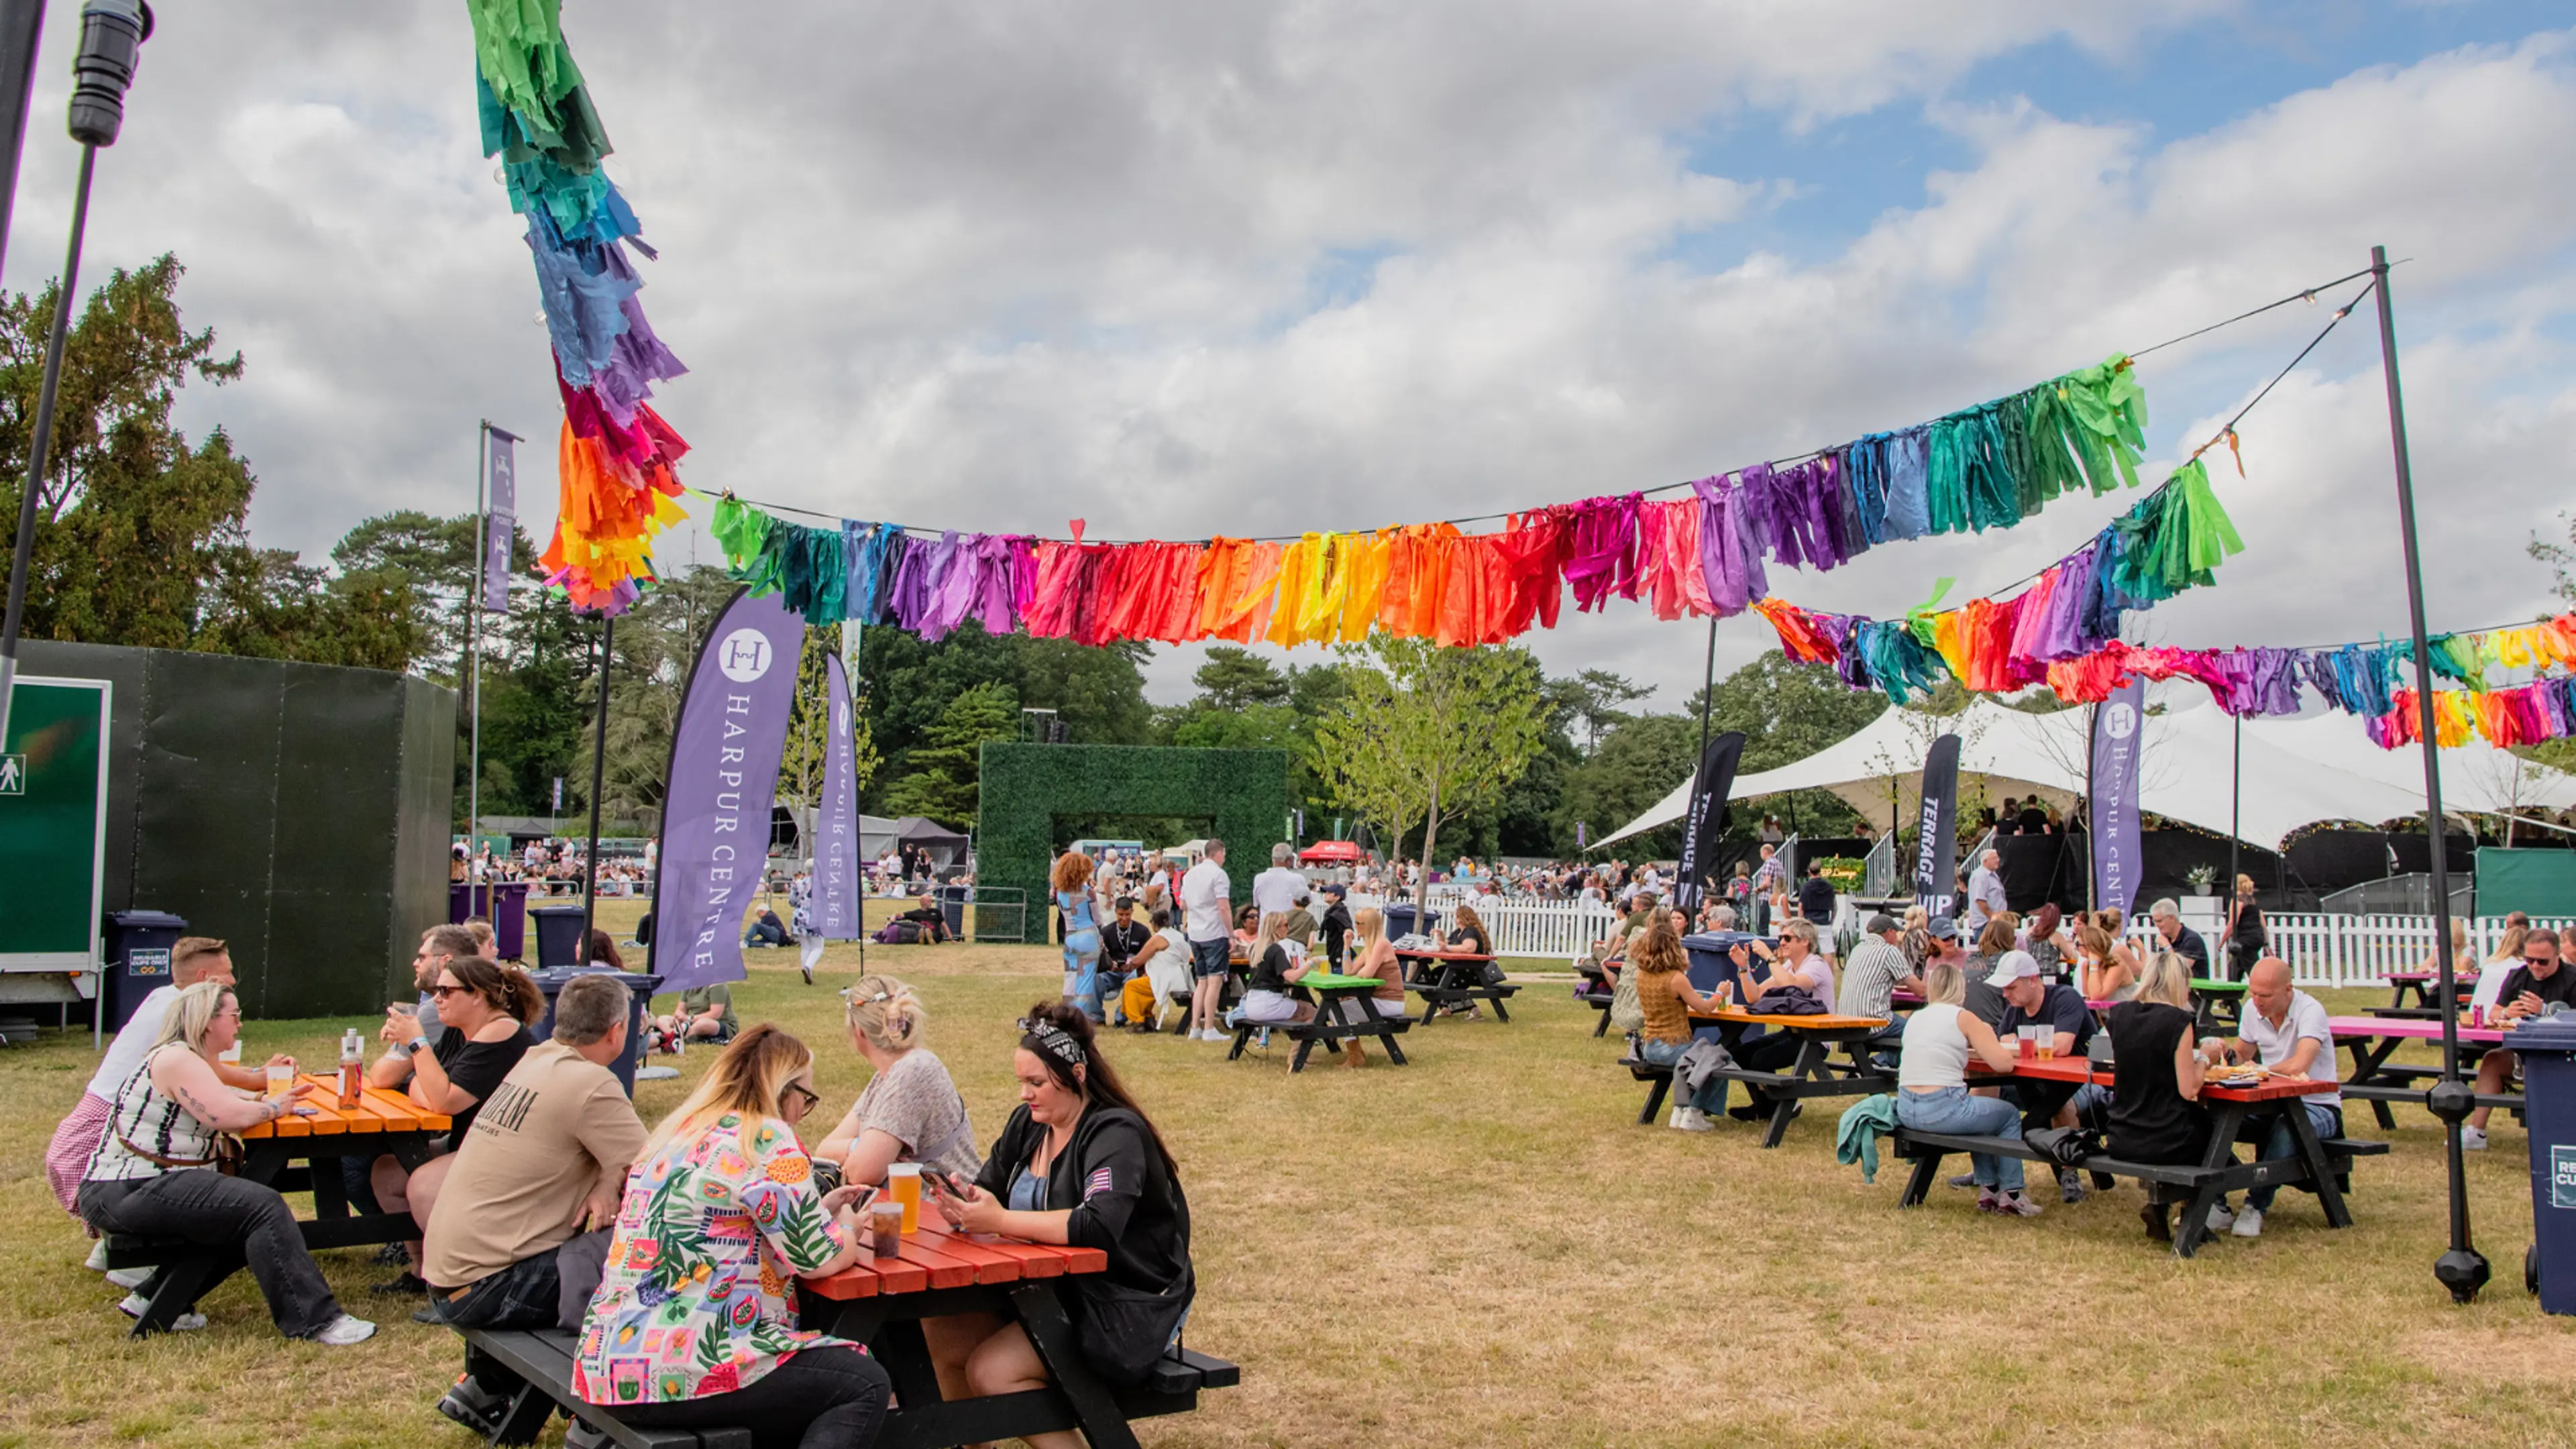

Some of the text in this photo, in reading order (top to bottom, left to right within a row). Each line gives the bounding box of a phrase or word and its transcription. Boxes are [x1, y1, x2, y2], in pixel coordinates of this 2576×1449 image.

[695, 693, 750, 969] HARPUR CENTRE
[1680, 882, 1703, 909] VP
[1918, 893, 1953, 917] VIP
